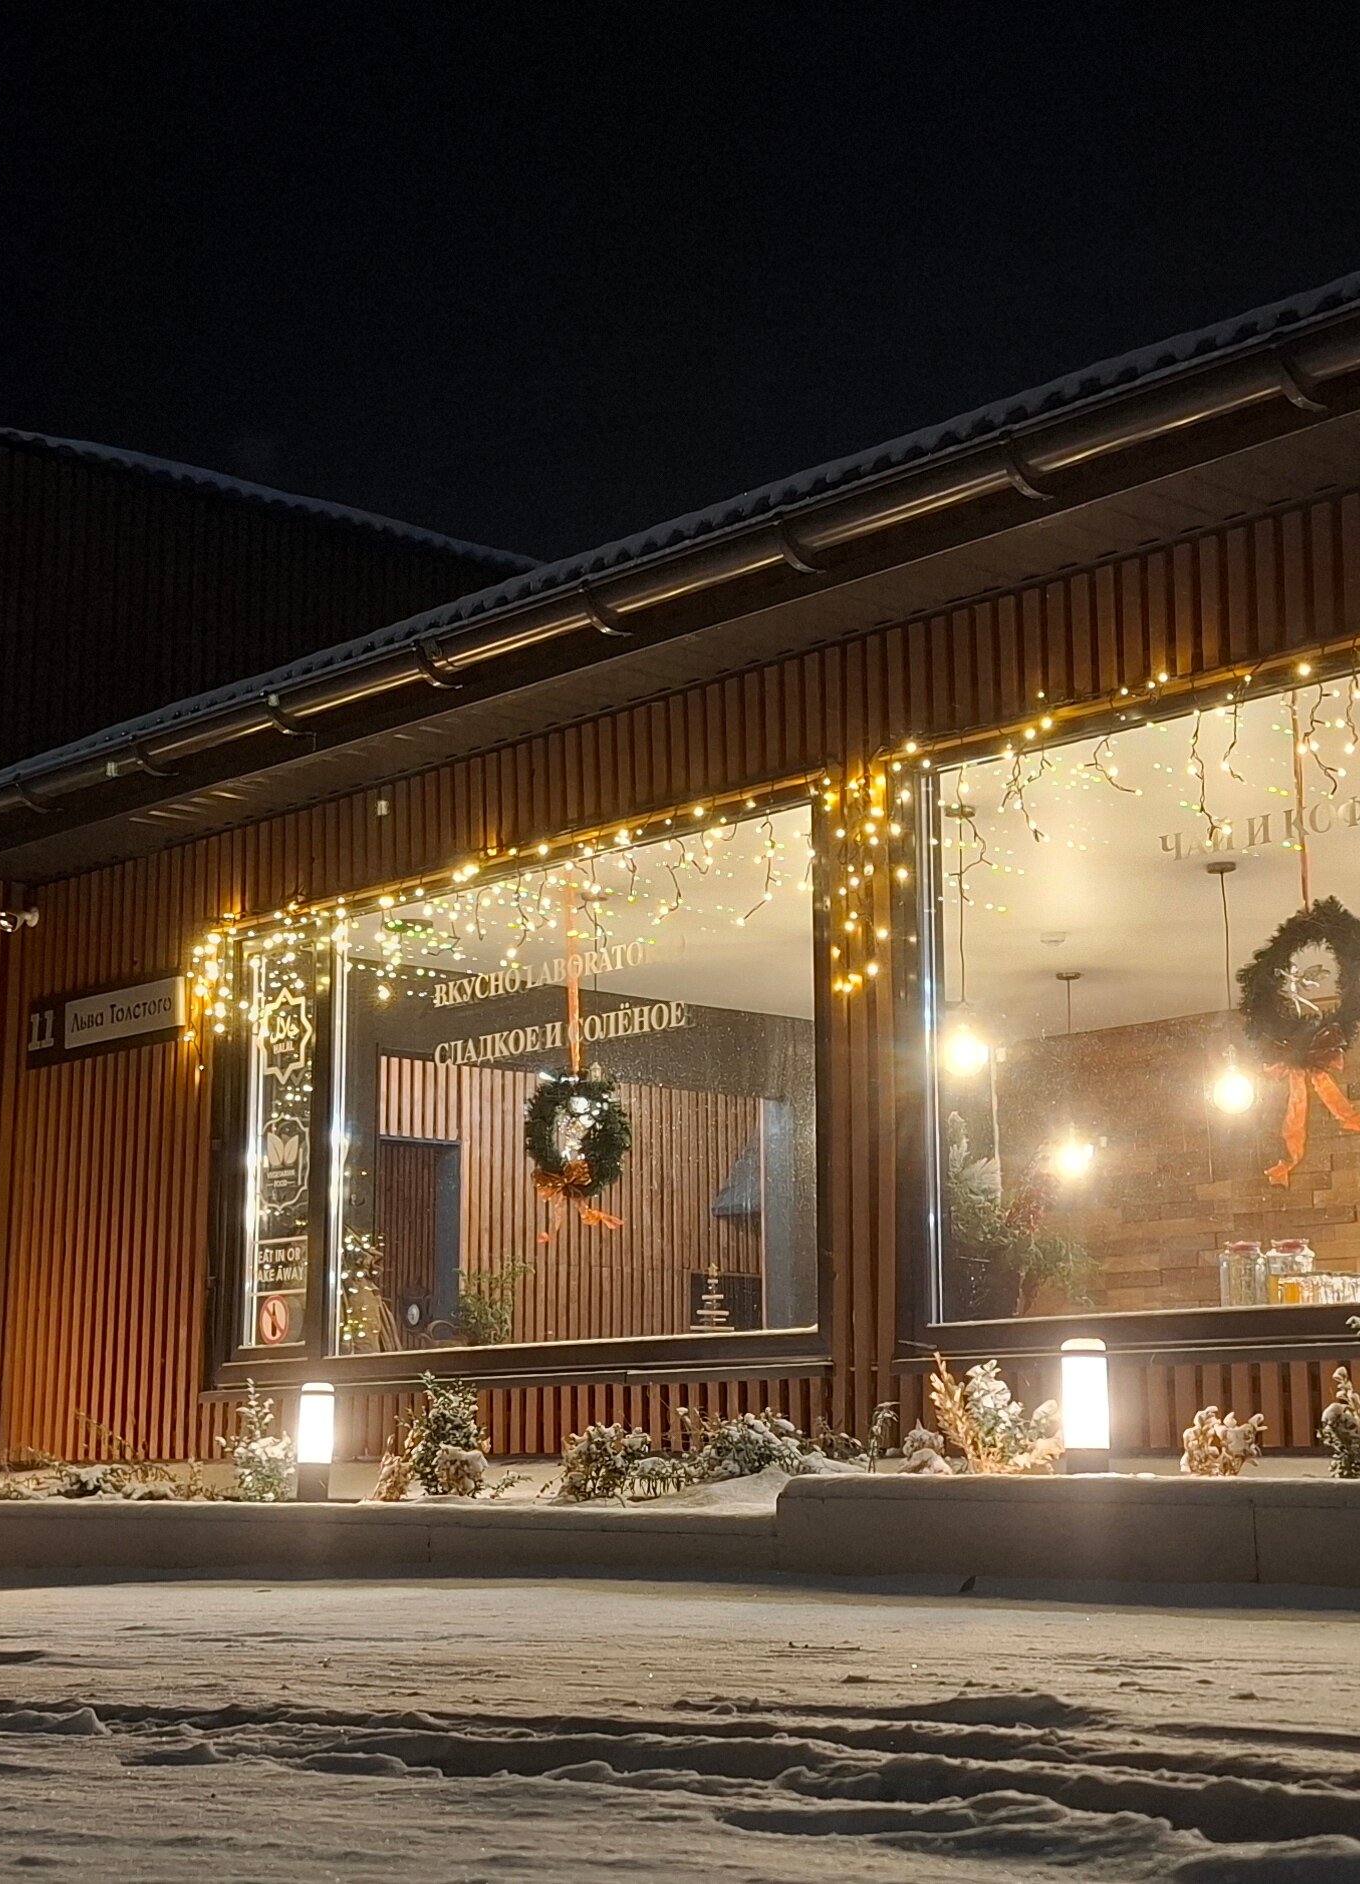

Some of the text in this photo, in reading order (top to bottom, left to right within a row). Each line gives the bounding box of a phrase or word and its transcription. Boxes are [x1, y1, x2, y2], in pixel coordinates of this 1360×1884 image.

[1246, 813, 1272, 848] И
[433, 966, 521, 1008] ВКУСНО
[28, 996, 172, 1051] 11 Льва Толстого
[434, 1001, 686, 1067] СЛАДКОЕ И СОЛЁНОЕ
[257, 1266, 304, 1282] AKE AWAY
